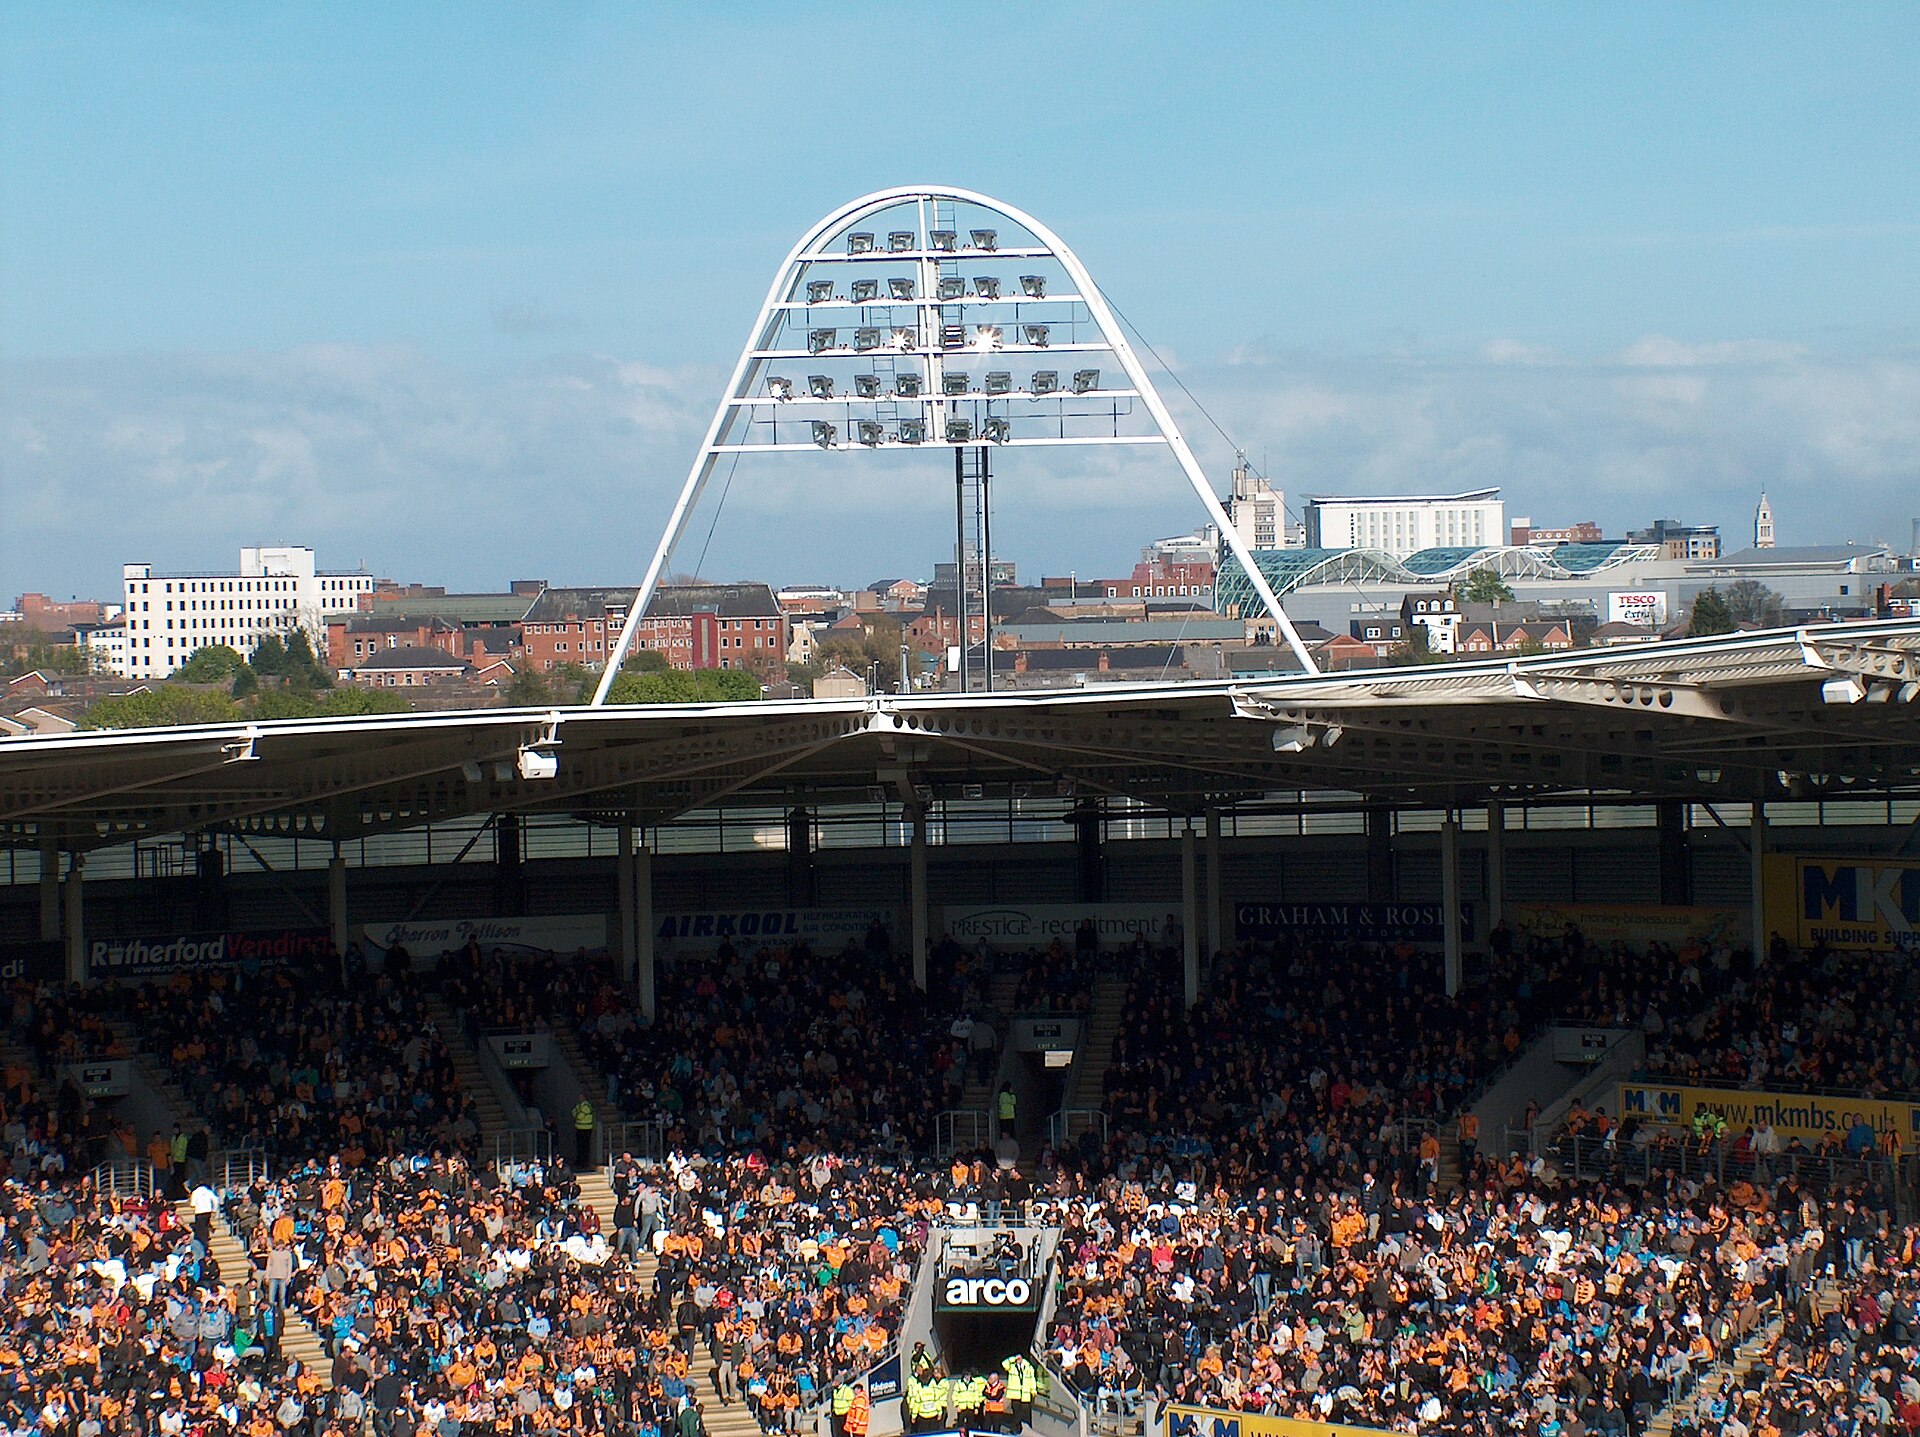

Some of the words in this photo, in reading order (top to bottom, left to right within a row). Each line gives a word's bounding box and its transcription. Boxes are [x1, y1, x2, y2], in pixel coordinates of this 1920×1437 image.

[1618, 595, 1656, 604] TESCO
[1624, 610, 1651, 619] extra
[657, 912, 799, 937] AIRKOOL
[1239, 906, 1349, 926] GRAHAM
[1359, 907, 1374, 925] &
[1811, 928, 1879, 943] BUILDING
[1625, 1089, 1681, 1118] MKM
[946, 1278, 1031, 1305] arco
